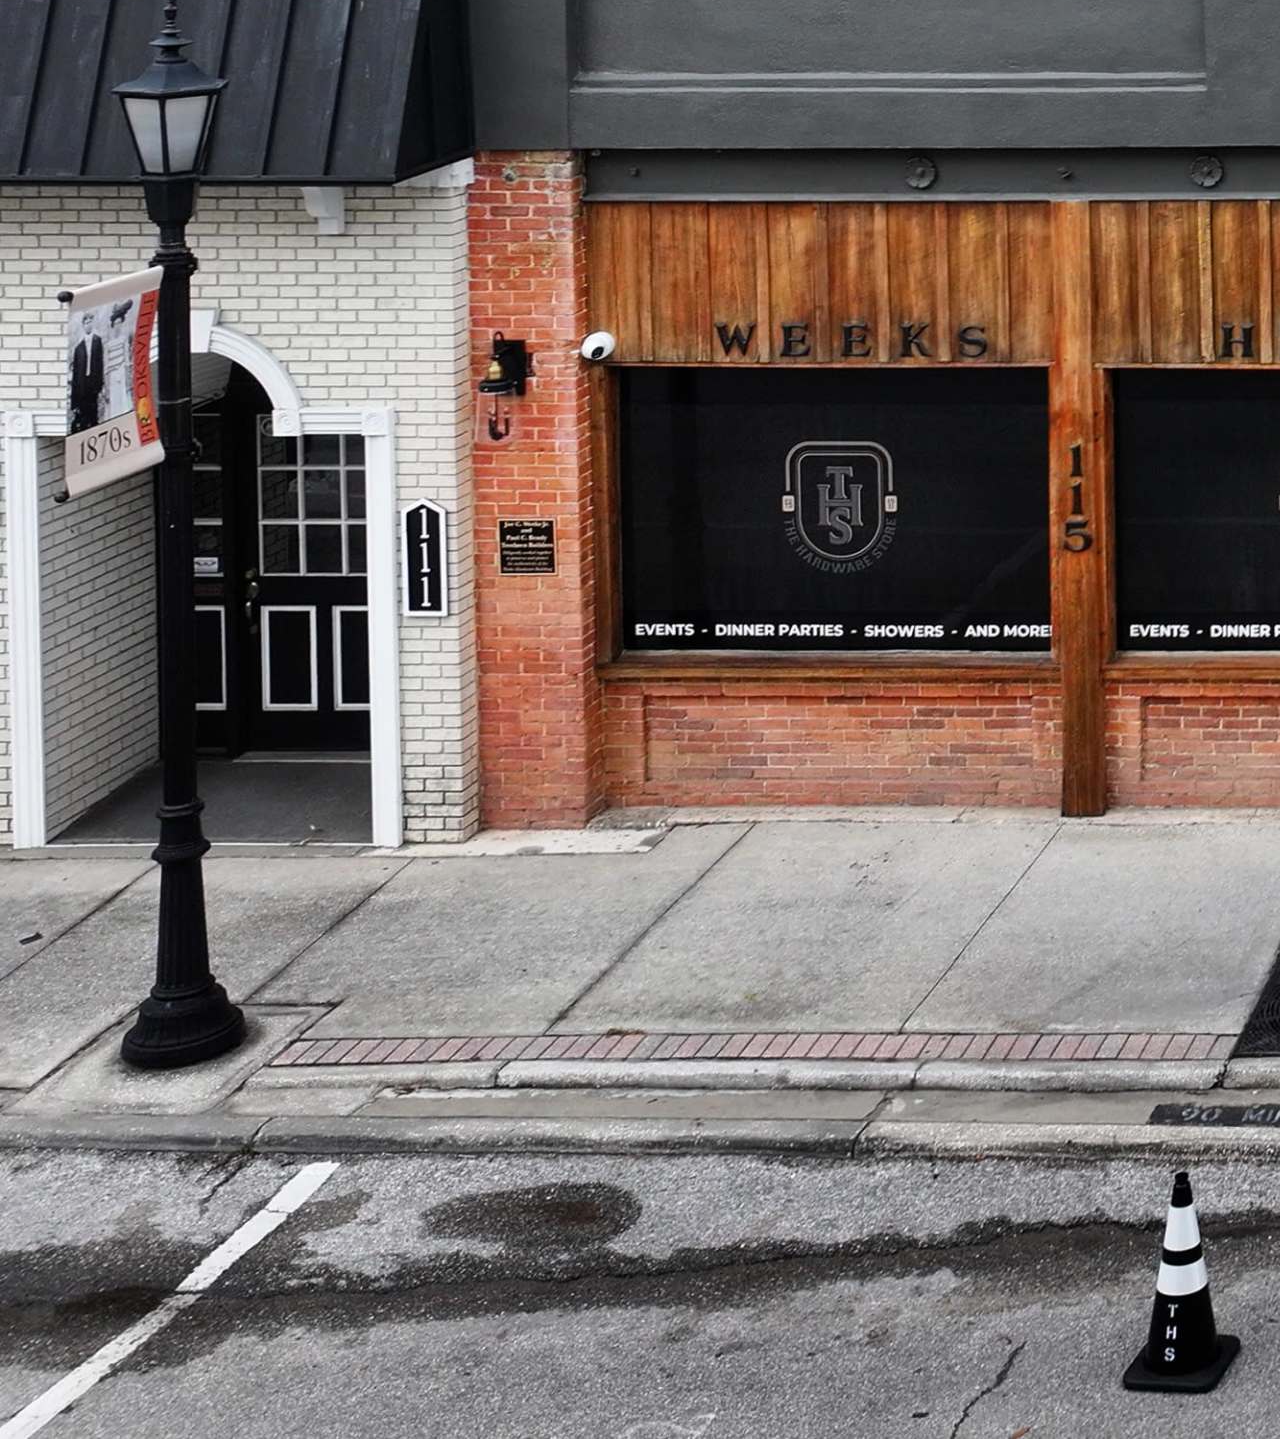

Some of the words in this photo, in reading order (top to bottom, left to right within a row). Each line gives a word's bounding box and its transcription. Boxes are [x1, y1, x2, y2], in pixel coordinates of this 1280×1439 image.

[714, 320, 988, 359] WEEKS
[79, 426, 132, 465] 1870s
[1062, 443, 1093, 554] 115
[418, 507, 432, 608] 111
[783, 517, 801, 546] THE
[795, 543, 874, 574] HARDWARE
[871, 517, 898, 560] STORE
[635, 623, 695, 637] EVENTS
[715, 623, 774, 637] DINNER
[778, 623, 844, 638] PARTIES
[864, 624, 945, 638] SHOWERS
[964, 624, 1000, 638] AND
[1003, 624, 1053, 638] MORE!
[1129, 624, 1189, 638] EVENTS
[1210, 624, 1271, 638] DINNER
